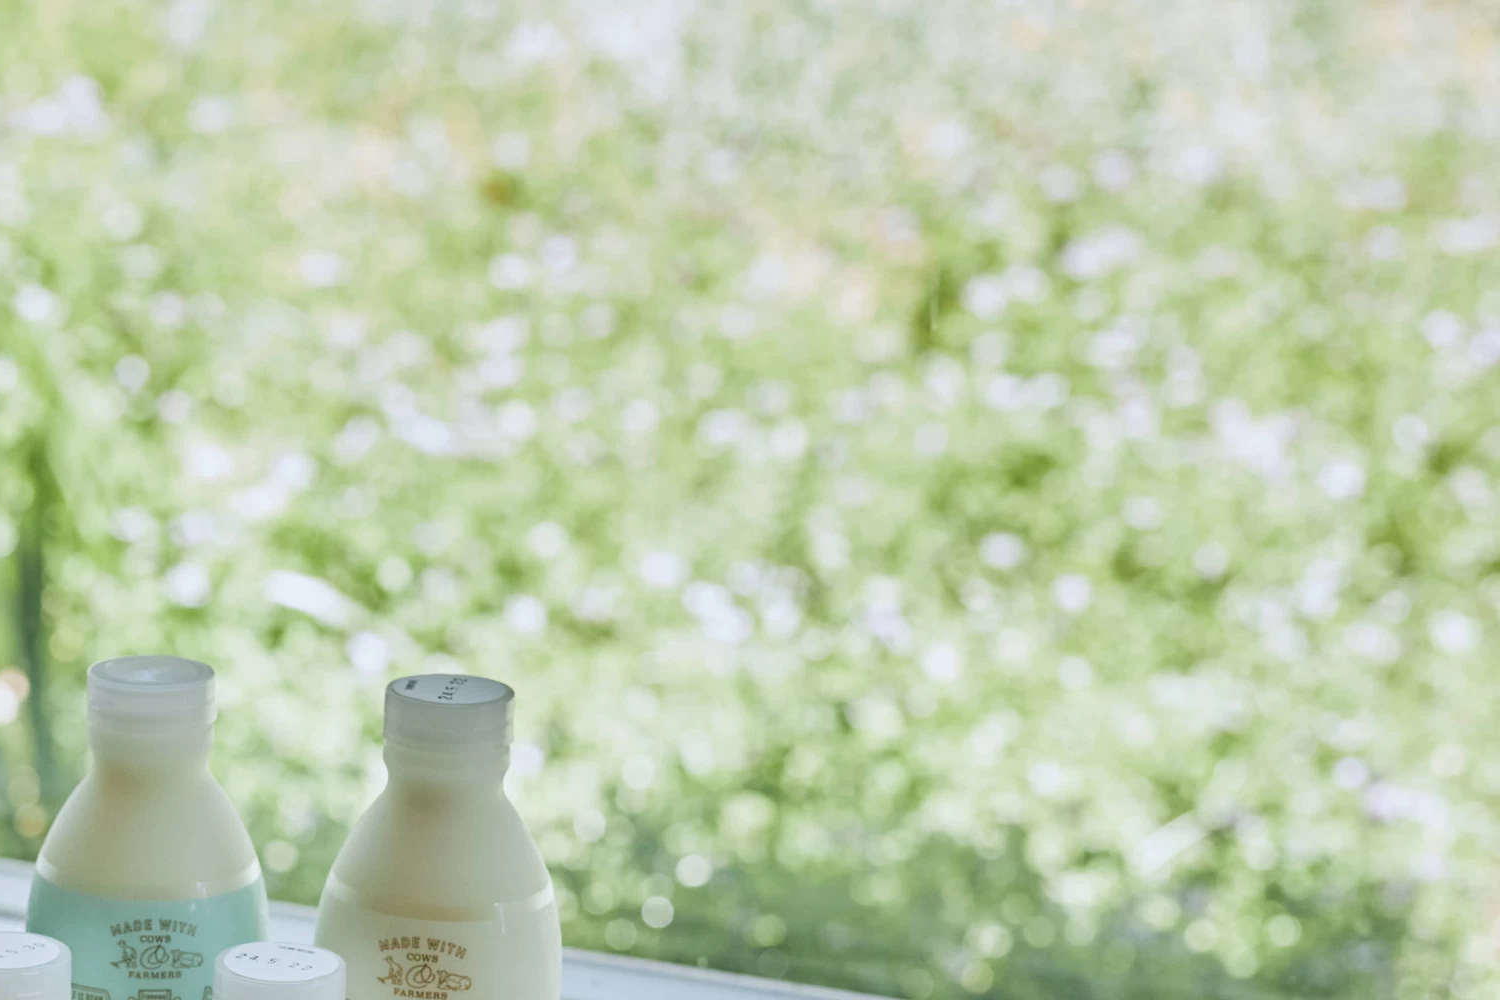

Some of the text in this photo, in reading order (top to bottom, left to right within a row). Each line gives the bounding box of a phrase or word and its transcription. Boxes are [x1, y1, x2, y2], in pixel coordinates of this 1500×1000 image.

[110, 919, 197, 937] MADE WITH
[140, 934, 172, 943] COWS
[379, 936, 467, 960] MADE WITH
[406, 953, 439, 963] COWS
[128, 970, 182, 980] FARMERS
[393, 988, 448, 1000] FARMERS
